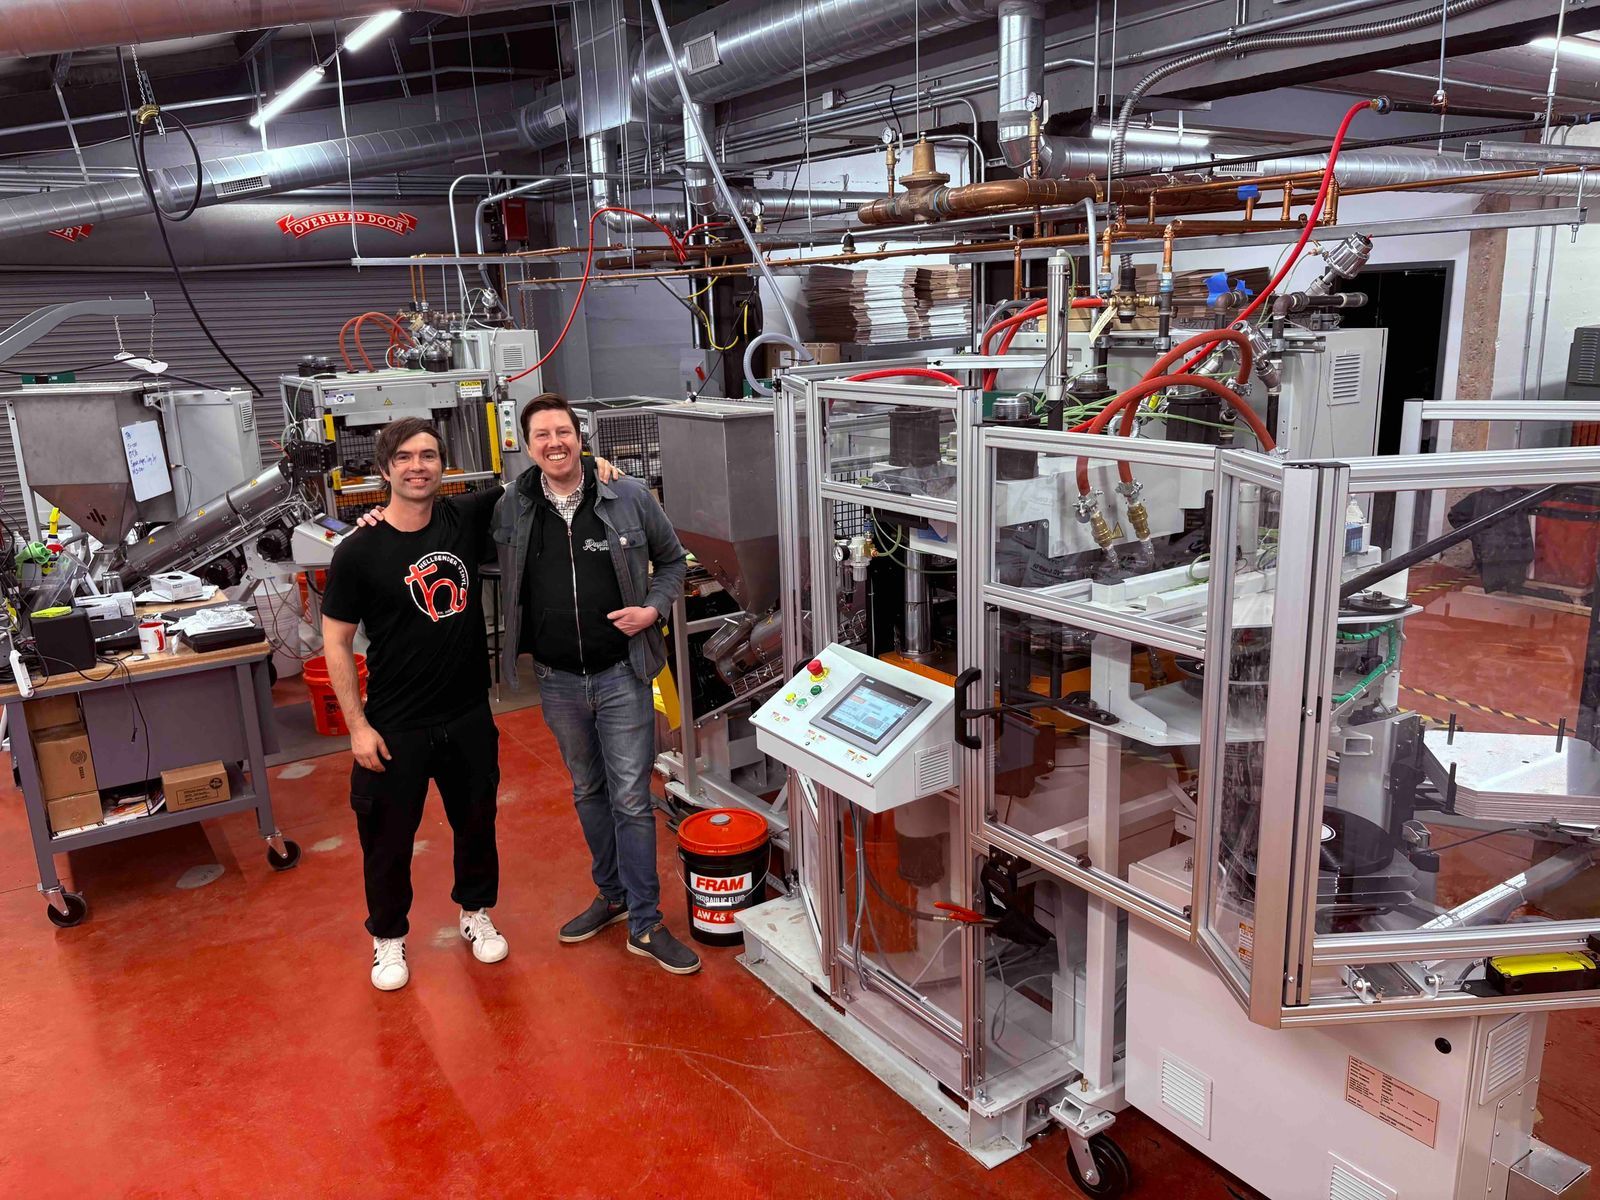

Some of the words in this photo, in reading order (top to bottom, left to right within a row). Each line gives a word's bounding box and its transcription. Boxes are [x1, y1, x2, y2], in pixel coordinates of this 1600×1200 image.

[294, 213, 365, 234] OVERHEAD
[368, 213, 403, 232] DOOR
[418, 555, 458, 570] HELLBENDER
[695, 876, 745, 892] FRAM
[697, 909, 711, 920] AW
[713, 912, 726, 922] 46
